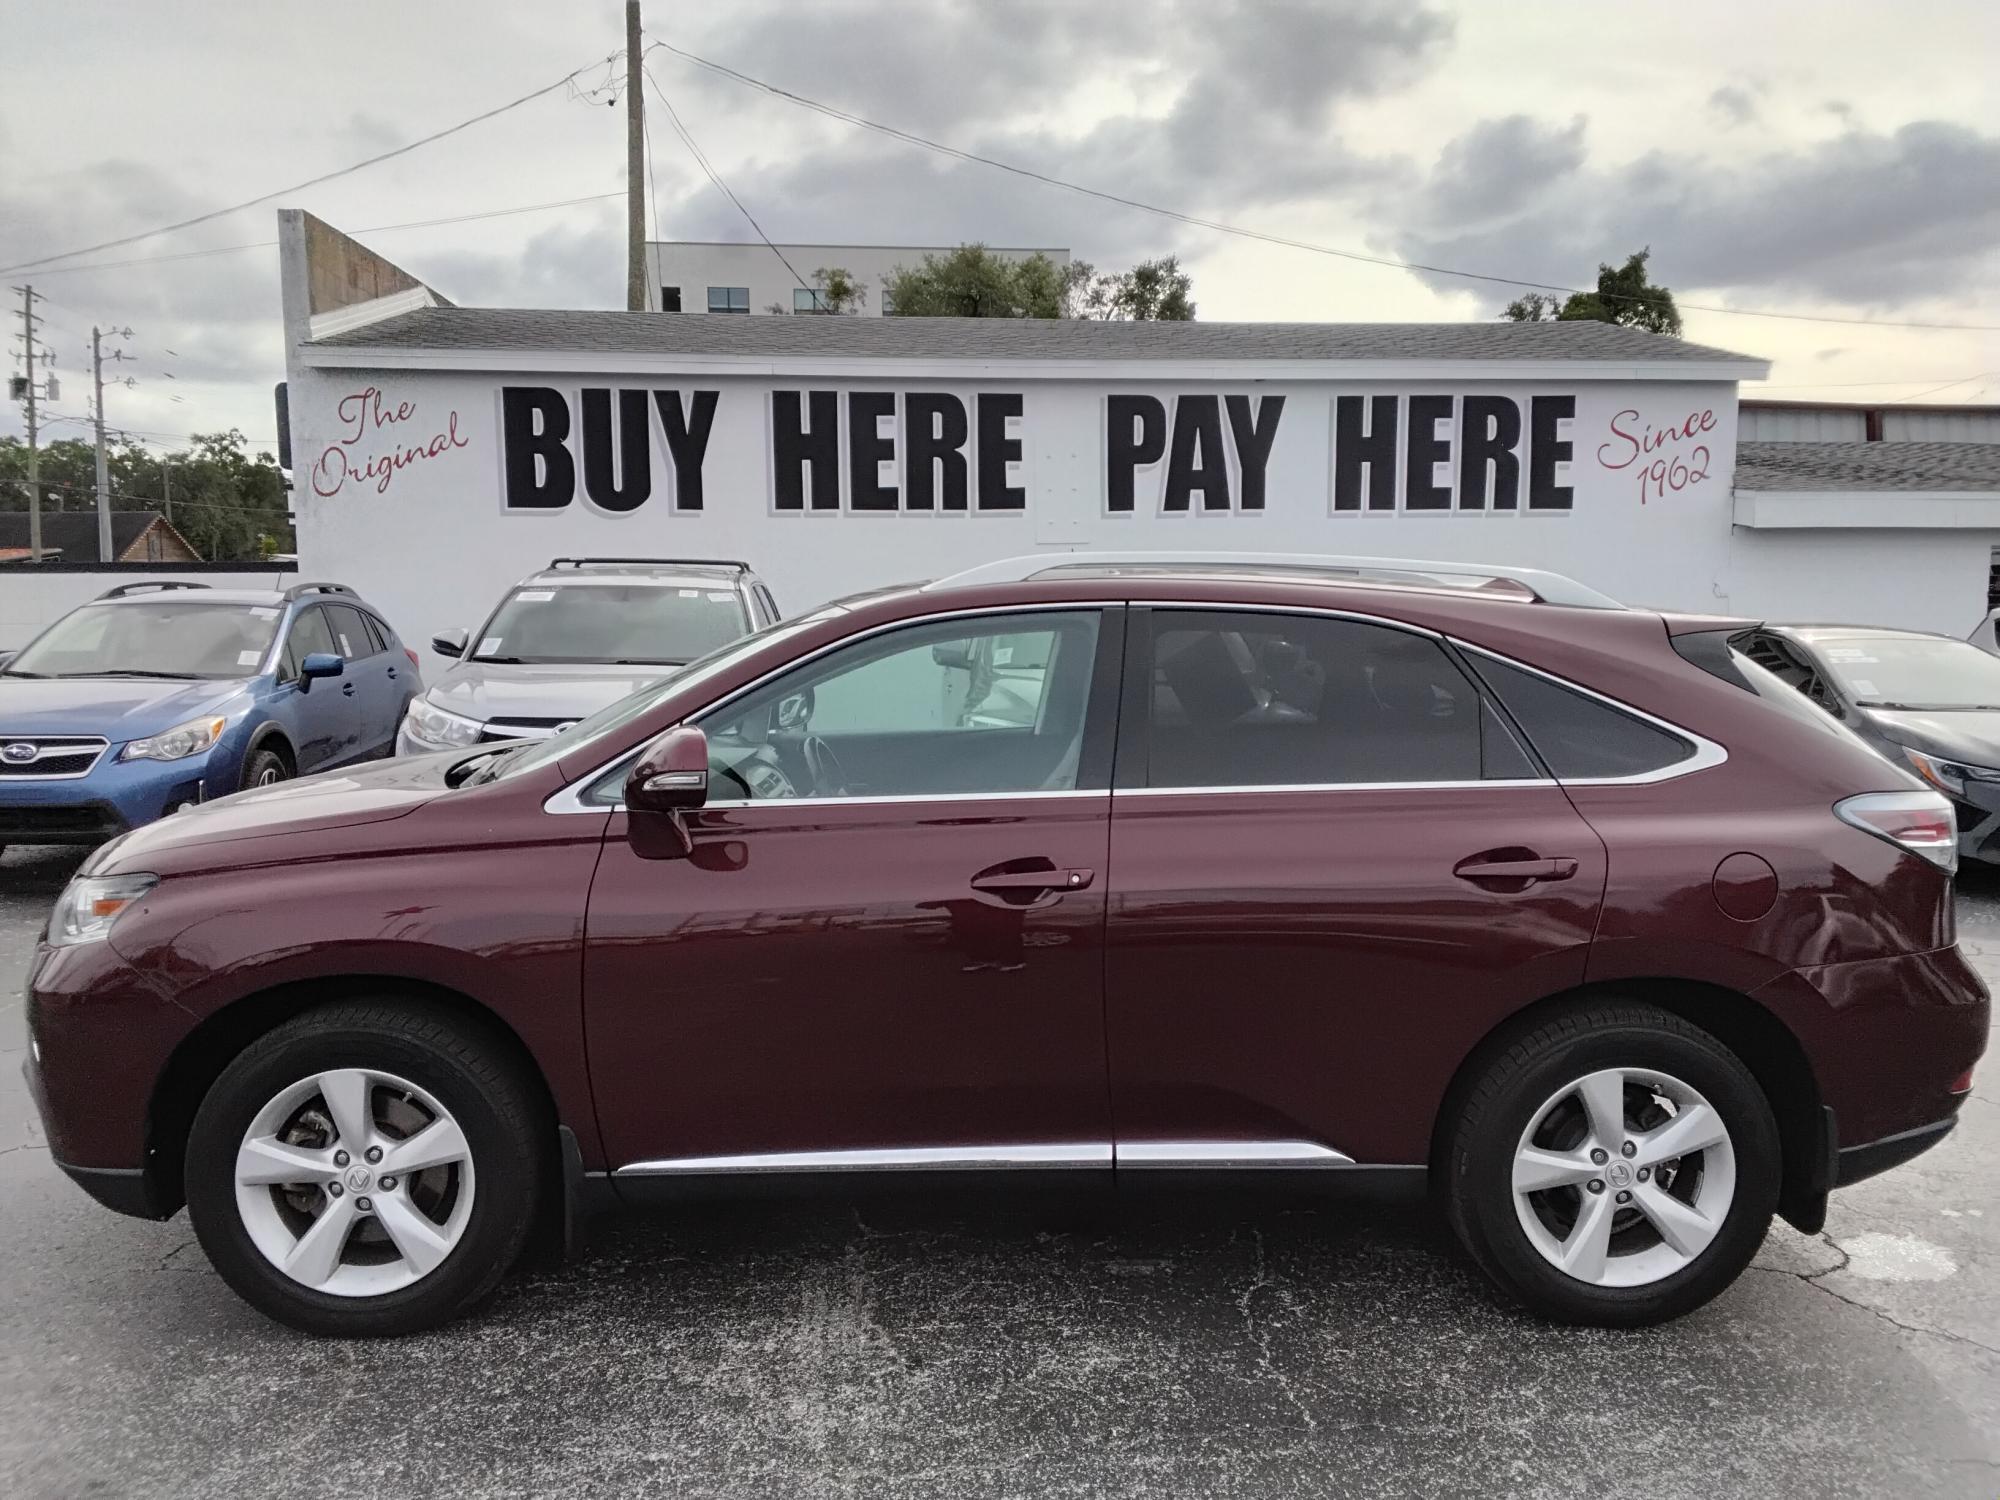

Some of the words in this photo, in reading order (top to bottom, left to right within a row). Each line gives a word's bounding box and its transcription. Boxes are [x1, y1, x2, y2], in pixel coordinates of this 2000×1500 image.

[337, 386, 417, 445] The
[1597, 408, 1718, 470] Since
[312, 410, 470, 498] Original
[501, 385, 721, 512] BUY
[771, 389, 1026, 511] HERE
[1106, 393, 1287, 512] PAY
[1333, 394, 1577, 511] HERE
[1636, 445, 1713, 506] 1962
